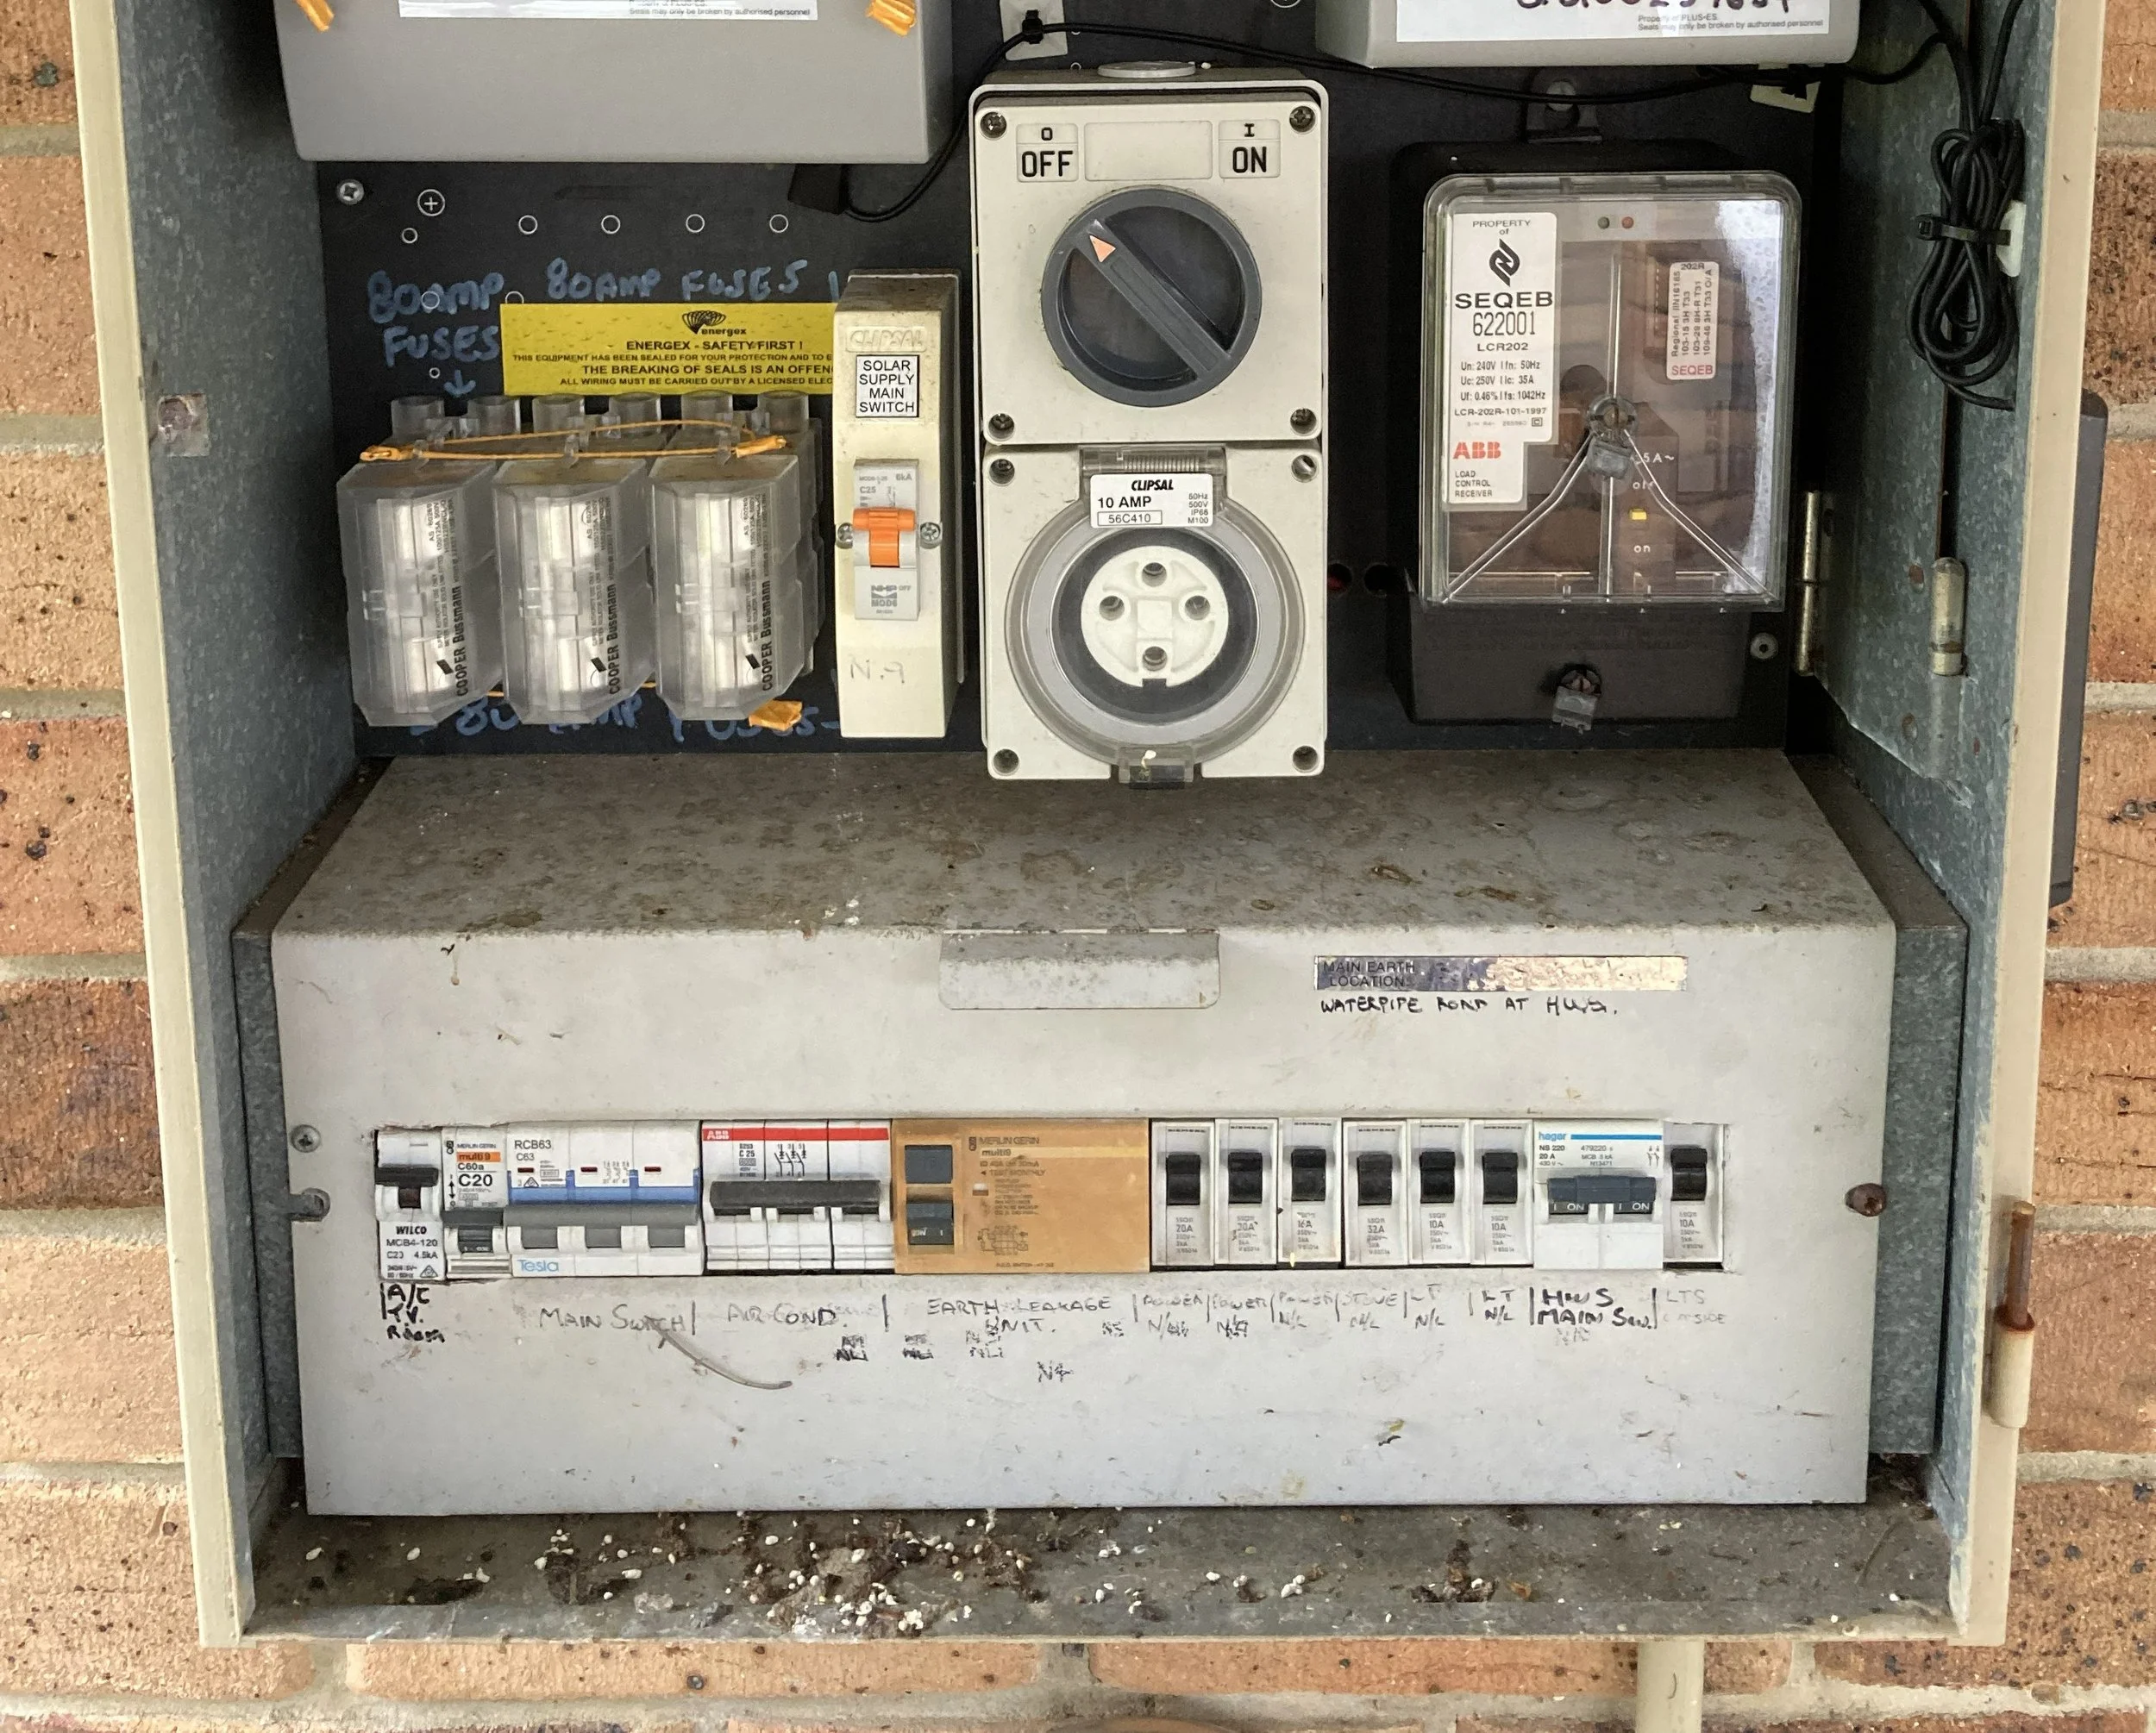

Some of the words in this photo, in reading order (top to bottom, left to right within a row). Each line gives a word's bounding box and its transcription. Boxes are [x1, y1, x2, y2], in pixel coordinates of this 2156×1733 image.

[1787, 19, 1824, 28] personnel
[1021, 150, 1074, 178] OFF
[1232, 146, 1267, 173] ON
[1472, 219, 1532, 228] PROPERTY
[681, 259, 807, 302] FUSES
[1455, 291, 1553, 310] SEQEB
[1473, 310, 1536, 337] 622001
[701, 327, 747, 336] energex
[382, 323, 500, 367] FUSES
[626, 341, 691, 351] ENERGEX
[702, 341, 753, 351] SAFETY
[756, 341, 795, 351] FIRST
[1476, 342, 1529, 352] LCR202
[583, 365, 609, 375] THE
[611, 365, 680, 375] BREAKING
[683, 365, 699, 375] OF
[705, 365, 747, 375] SEALS
[750, 365, 763, 375] IS
[766, 365, 784, 375] AN
[863, 360, 911, 372] SOLAR
[1461, 361, 1475, 371] Un:
[1476, 360, 1496, 371] 240V
[1520, 360, 1540, 370] 50Hz
[1671, 365, 1714, 376] SEQEB
[859, 373, 915, 385] SUPPLY
[1461, 376, 1474, 385] Uc:
[1476, 375, 1495, 385] 250V
[1518, 374, 1534, 385] 35A
[869, 387, 905, 399] MAIN
[1460, 391, 1472, 401] Uf:
[1518, 390, 1546, 400] 1042Hz
[859, 401, 915, 413] SWITCH
[1454, 407, 1546, 416] LCR-202R-101-1997
[1452, 441, 1501, 460] ABB
[1131, 479, 1175, 491] CLIPSAL
[1455, 479, 1491, 488] CONTROL
[859, 485, 876, 494] C25
[1098, 497, 1114, 509] 10
[1119, 496, 1152, 508] AMP
[1108, 513, 1151, 524] 56C410
[1633, 545, 1651, 554] on
[605, 585, 619, 641] Bussmann
[760, 579, 772, 636] Bussmann
[452, 586, 466, 643] Bussmann
[454, 645, 469, 697] COOPER
[607, 643, 622, 696] COOPER
[760, 641, 775, 691] COOPER
[1323, 961, 1361, 973] MAIN
[1367, 961, 1415, 973] EARTH
[1320, 996, 1423, 1014] WATERPIPE
[1505, 997, 1530, 1012] AT
[706, 1130, 730, 1140] ABB
[980, 1136, 1012, 1145] MERLIN
[1012, 1136, 1040, 1145] GERIN
[1538, 1132, 1567, 1142] hager
[514, 1139, 552, 1150] RCB63
[516, 1152, 535, 1161] C63
[457, 1162, 485, 1171] C60a
[458, 1173, 493, 1187] C20
[1566, 1203, 1585, 1211] ON
[1175, 1223, 1194, 1233] 20A
[1237, 1222, 1255, 1231] 20A
[1368, 1224, 1385, 1234] 32A
[1429, 1220, 1445, 1229] 10A
[1491, 1223, 1507, 1231] 10A
[1679, 1219, 1695, 1228] 10A
[396, 1225, 427, 1235] WILCO
[386, 1238, 438, 1247] MCB4-120
[517, 1259, 559, 1273] Tesla
[387, 1283, 430, 1310] A/C
[1341, 1292, 1398, 1307] STOVE
[1482, 1289, 1515, 1303] LT
[1665, 1289, 1707, 1304] LTS
[927, 1298, 1000, 1316] EARTH
[1018, 1296, 1112, 1312] LEAKAGE
[539, 1307, 602, 1328] MAIN
[1537, 1310, 1603, 1325] MAIN
